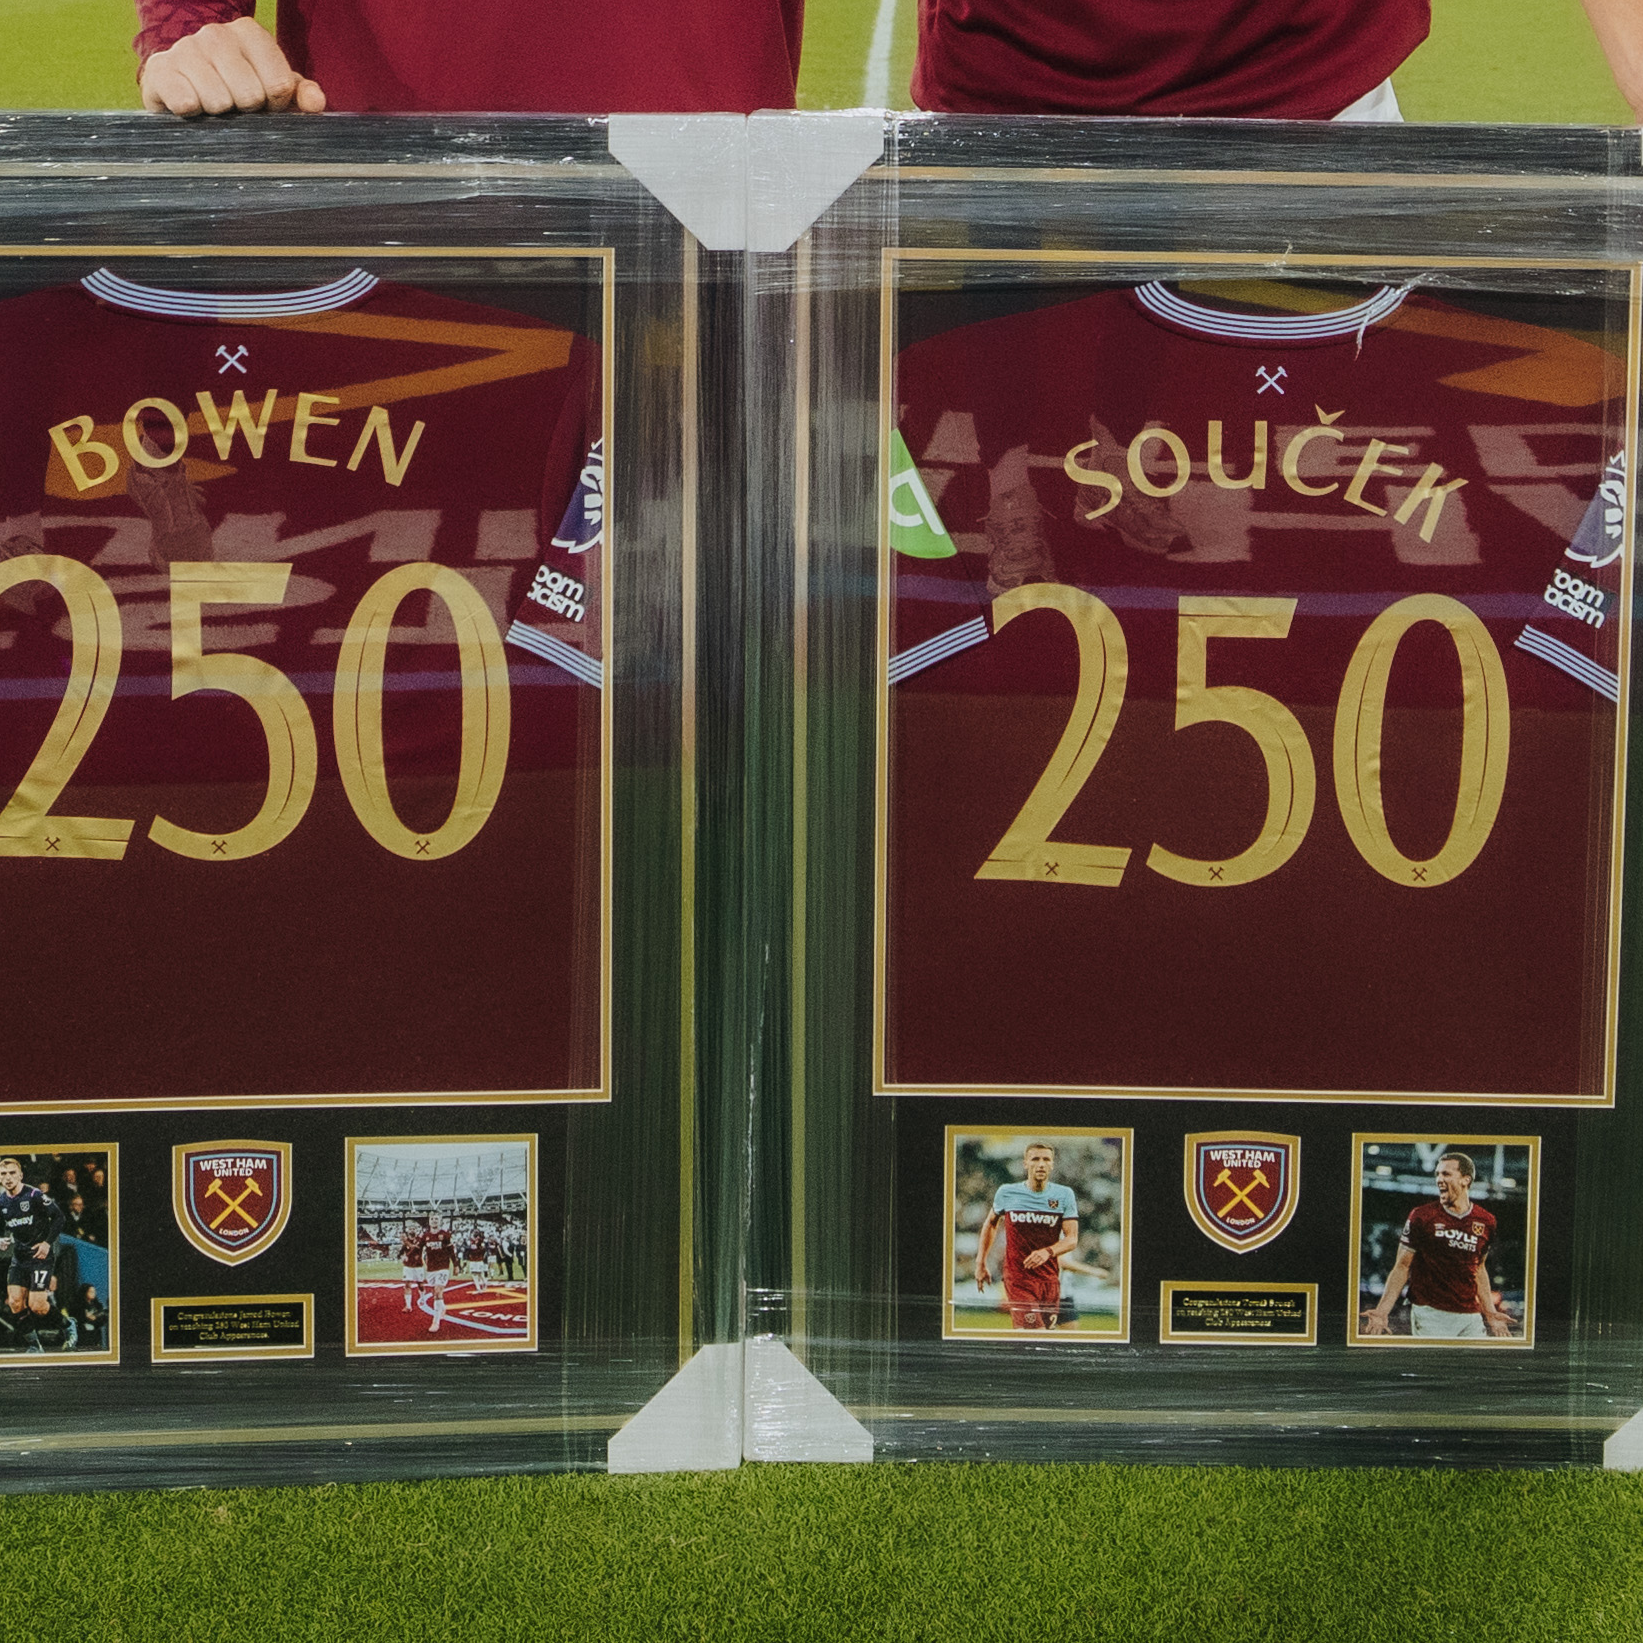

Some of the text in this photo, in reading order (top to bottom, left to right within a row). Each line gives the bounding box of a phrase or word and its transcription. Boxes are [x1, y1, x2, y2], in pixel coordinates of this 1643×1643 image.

[48, 389, 426, 492] BOWEN
[1063, 403, 1469, 544] SOUČEK
[536, 564, 585, 601] oom
[1554, 569, 1605, 607] oom
[1544, 585, 1605, 628] acism
[974, 583, 1510, 887] 250
[1210, 1150, 1275, 1163] WEST HAM
[1223, 1159, 1261, 1169] UNITED
[200, 1158, 267, 1171] WEST HAM
[214, 1168, 253, 1177] UNITED
[6, 1214, 34, 1228] etway
[1010, 1211, 1059, 1227] betway
[219, 1228, 250, 1237] LONDON
[34, 1270, 48, 1284] 17
